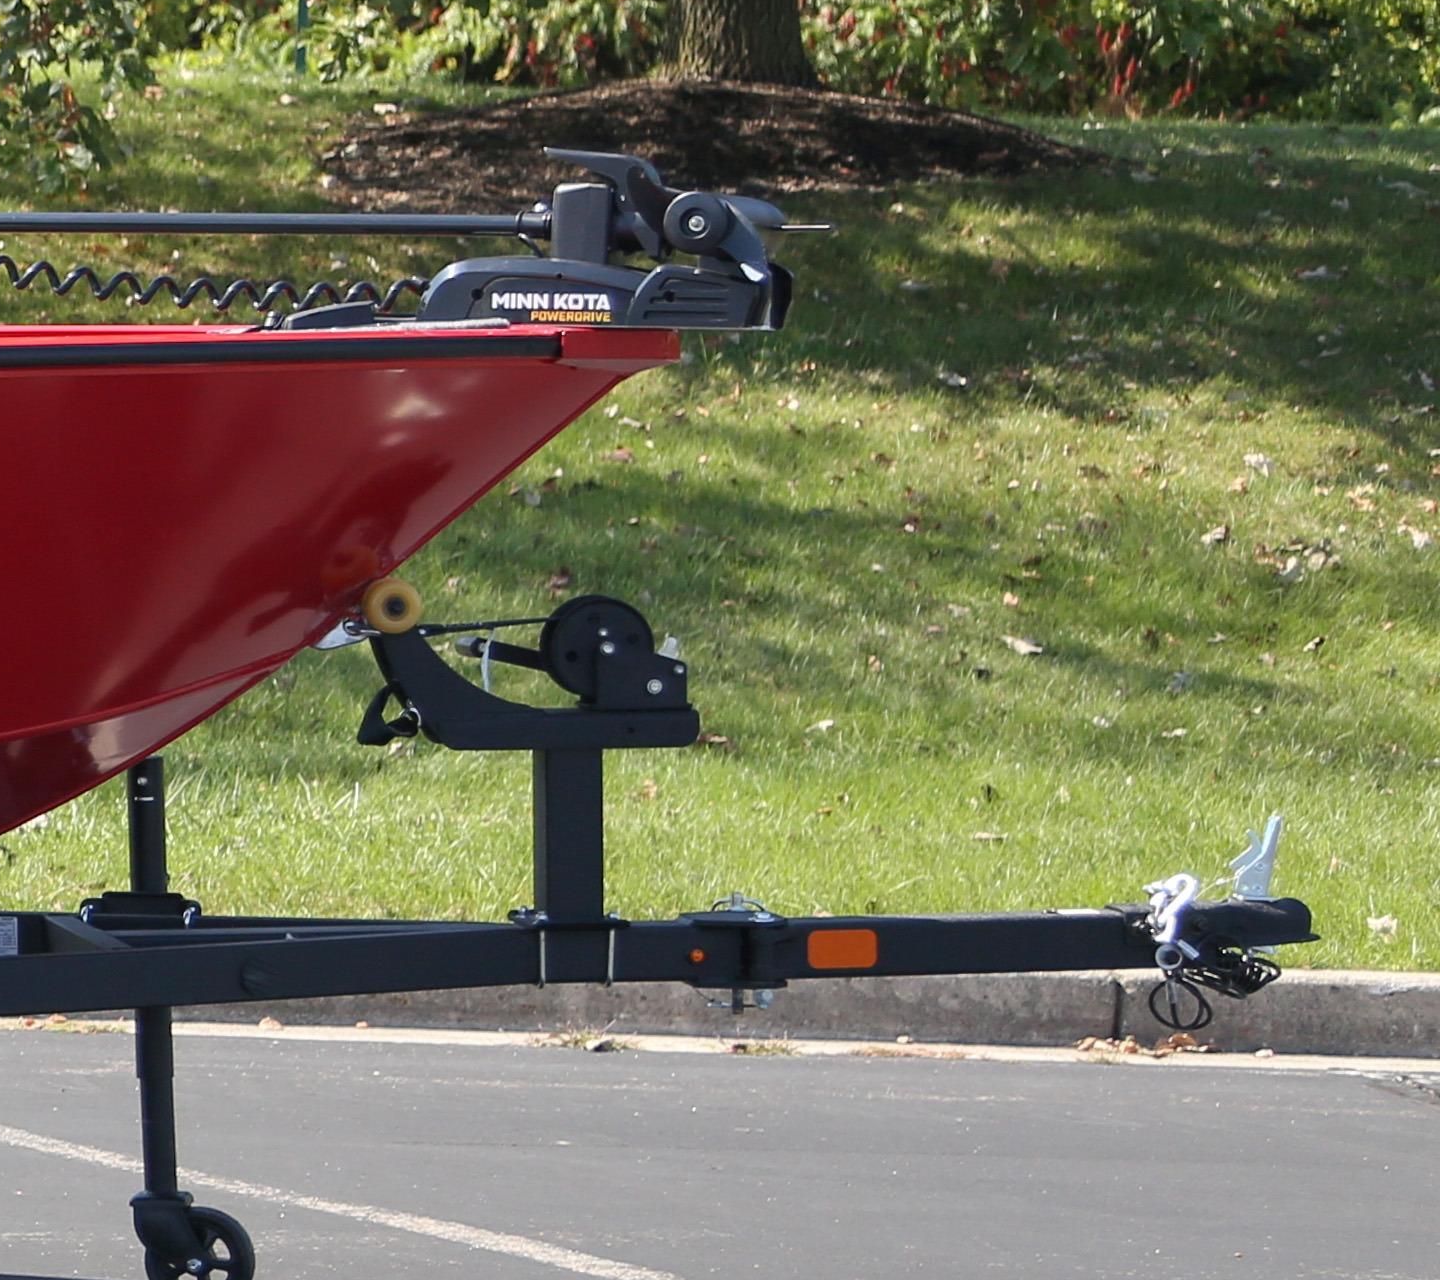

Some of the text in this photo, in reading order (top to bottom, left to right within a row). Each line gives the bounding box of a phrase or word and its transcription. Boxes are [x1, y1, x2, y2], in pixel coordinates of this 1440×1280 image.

[491, 292, 611, 310] MINN KOTA
[530, 311, 612, 323] POWERDRIVE
